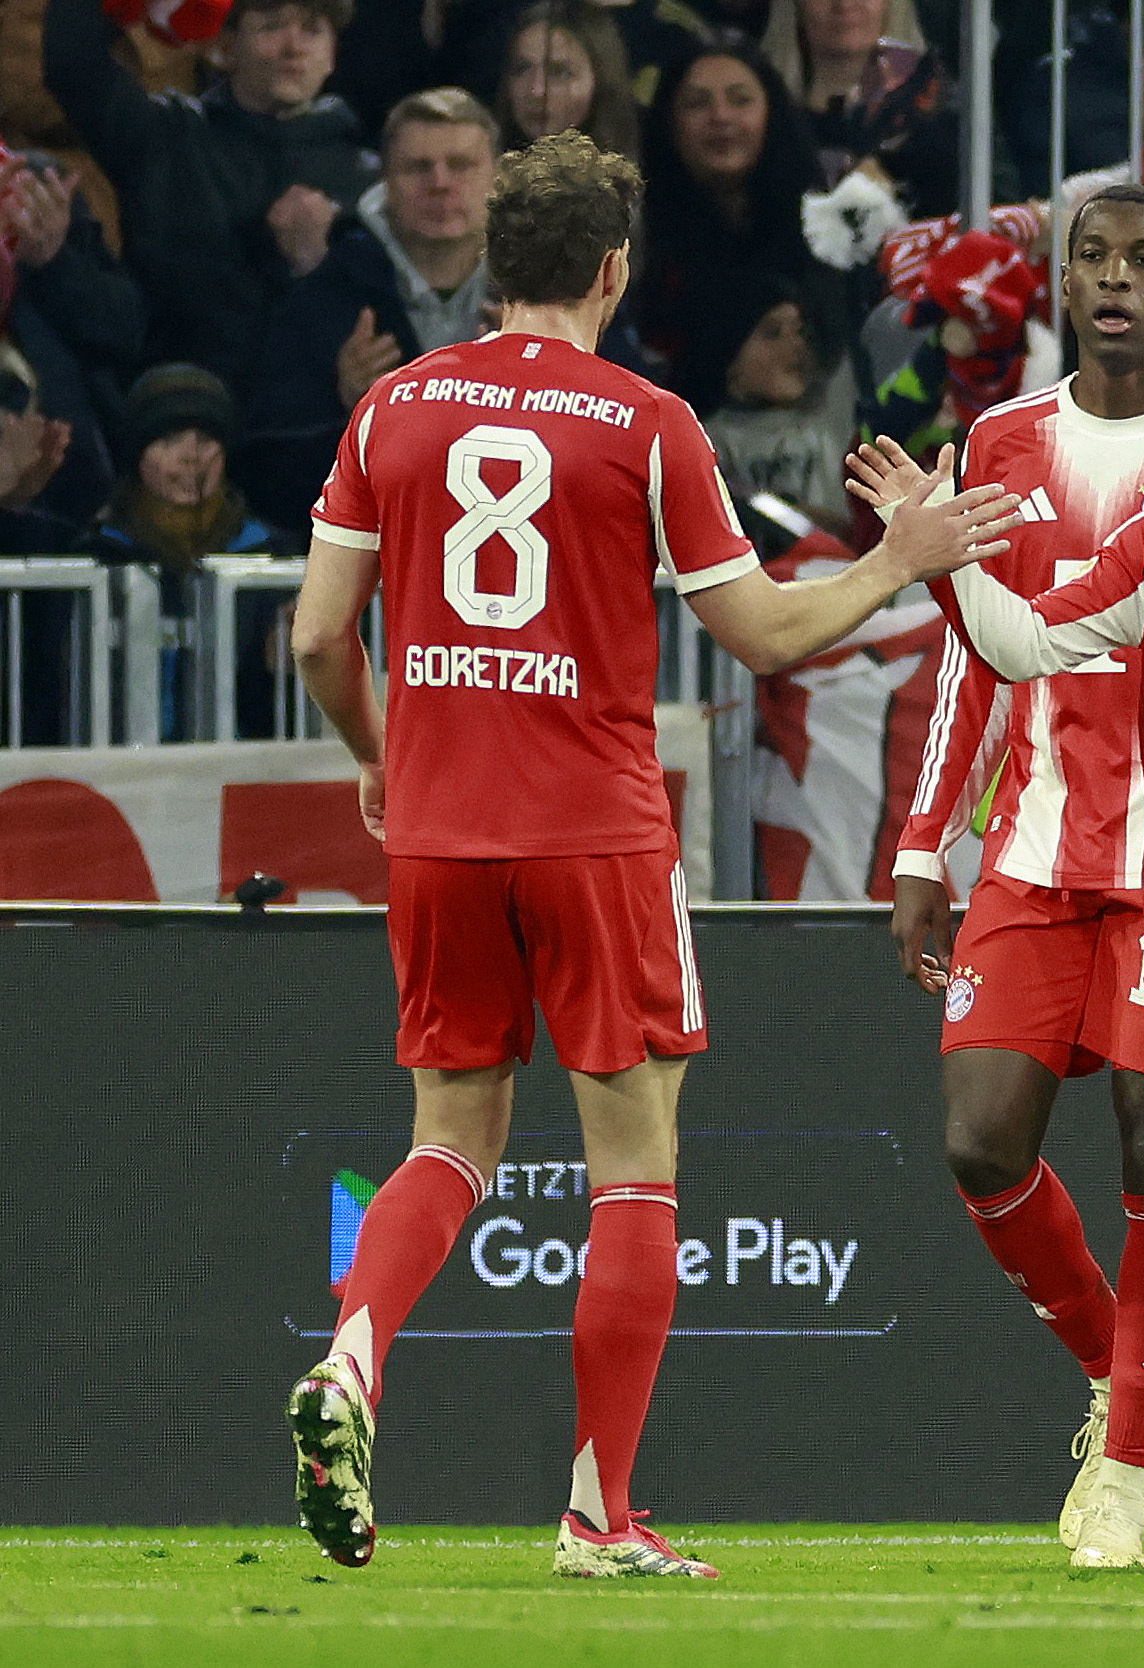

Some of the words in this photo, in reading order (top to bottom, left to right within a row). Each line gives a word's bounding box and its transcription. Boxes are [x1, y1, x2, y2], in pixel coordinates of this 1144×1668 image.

[389, 381, 418, 405] FC
[422, 378, 516, 410] BAYERN
[521, 389, 635, 429] MÜNCHEN
[443, 424, 552, 630] 8
[405, 644, 579, 699] GORETZKA
[727, 1217, 859, 1305] Play
